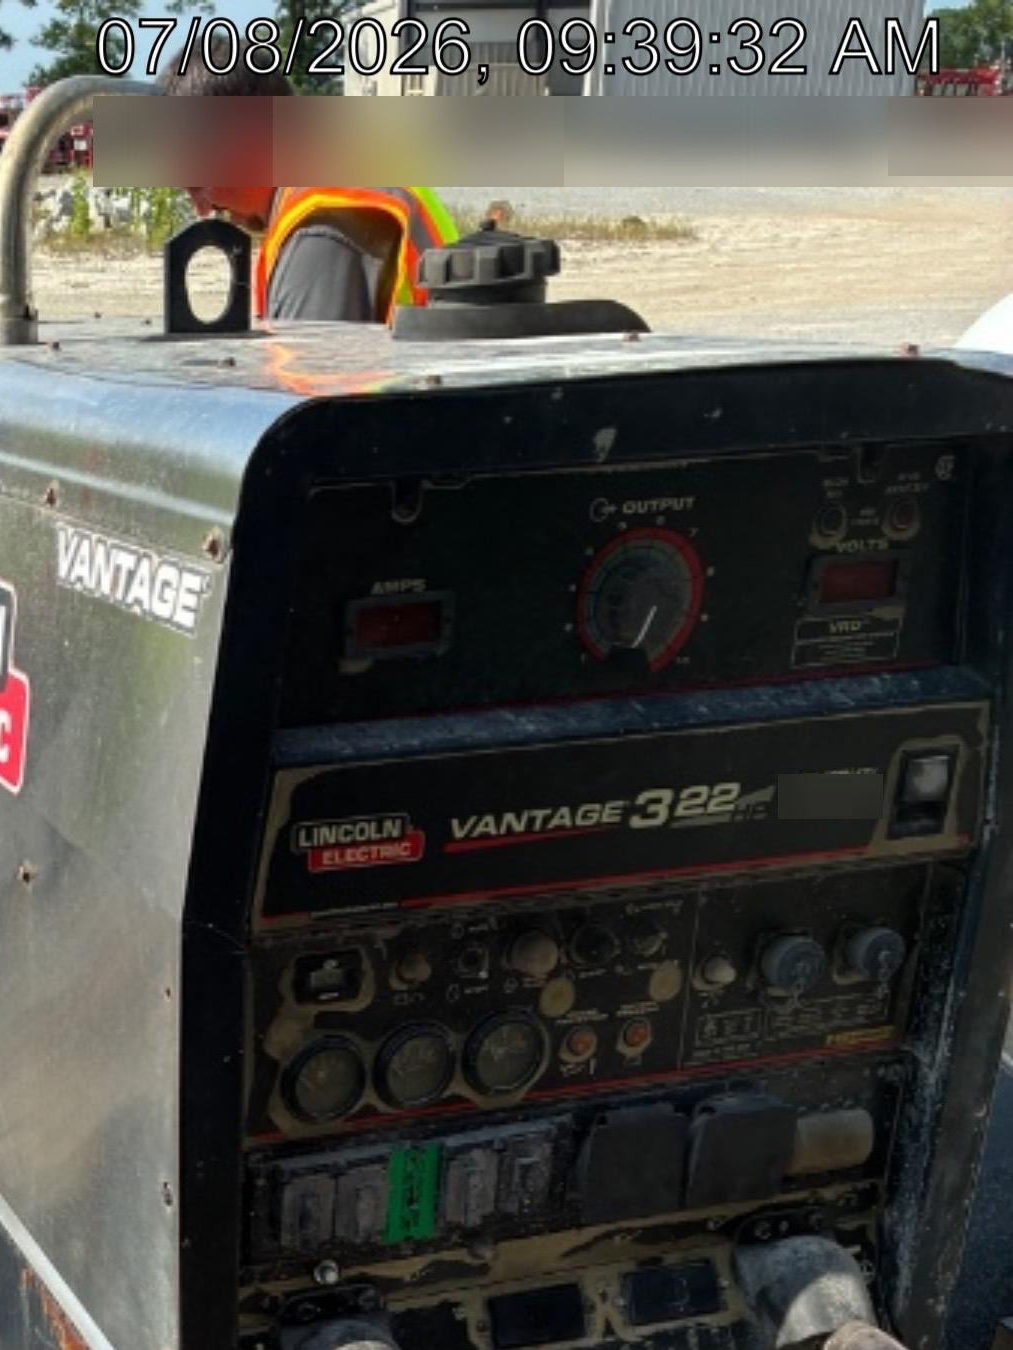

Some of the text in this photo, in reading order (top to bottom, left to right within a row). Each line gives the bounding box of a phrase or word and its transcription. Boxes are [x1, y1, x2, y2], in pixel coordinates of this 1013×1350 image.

[622, 497, 696, 514] OUTPUT
[836, 539, 889, 552] VOLTS
[56, 529, 202, 629] VANTAGE
[371, 577, 426, 595] AMPS
[451, 800, 624, 838] VANTAGE
[629, 782, 741, 829] 322
[299, 818, 403, 848] LINCOLN
[322, 842, 412, 866] ELECTRIC
